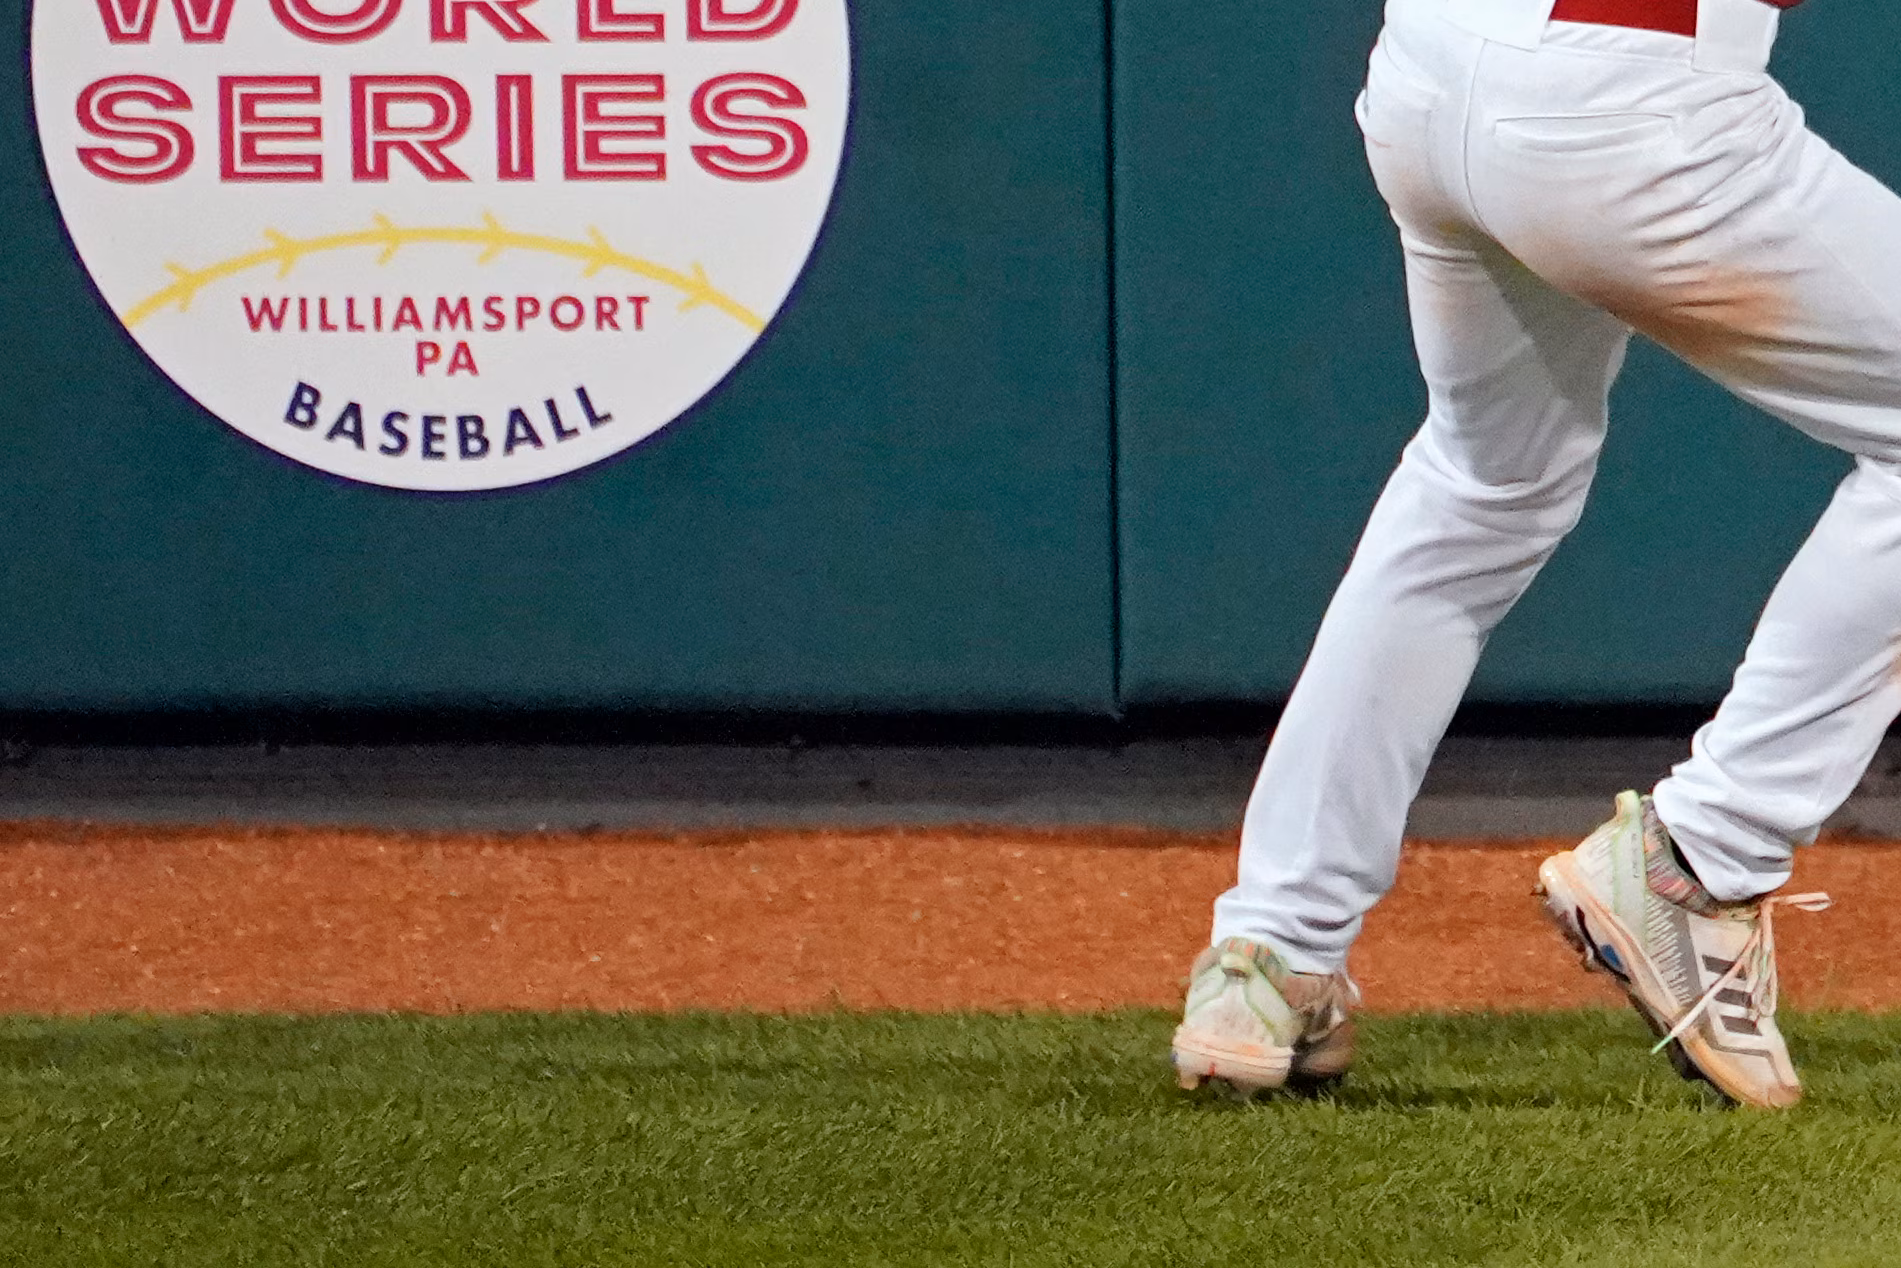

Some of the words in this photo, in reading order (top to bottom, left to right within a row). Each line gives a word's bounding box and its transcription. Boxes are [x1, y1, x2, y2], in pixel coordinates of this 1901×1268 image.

[75, 71, 810, 185] SERIES
[241, 295, 651, 332] WILLIAMSPORT
[416, 340, 480, 376] PA
[283, 380, 614, 461] BASEBALL
